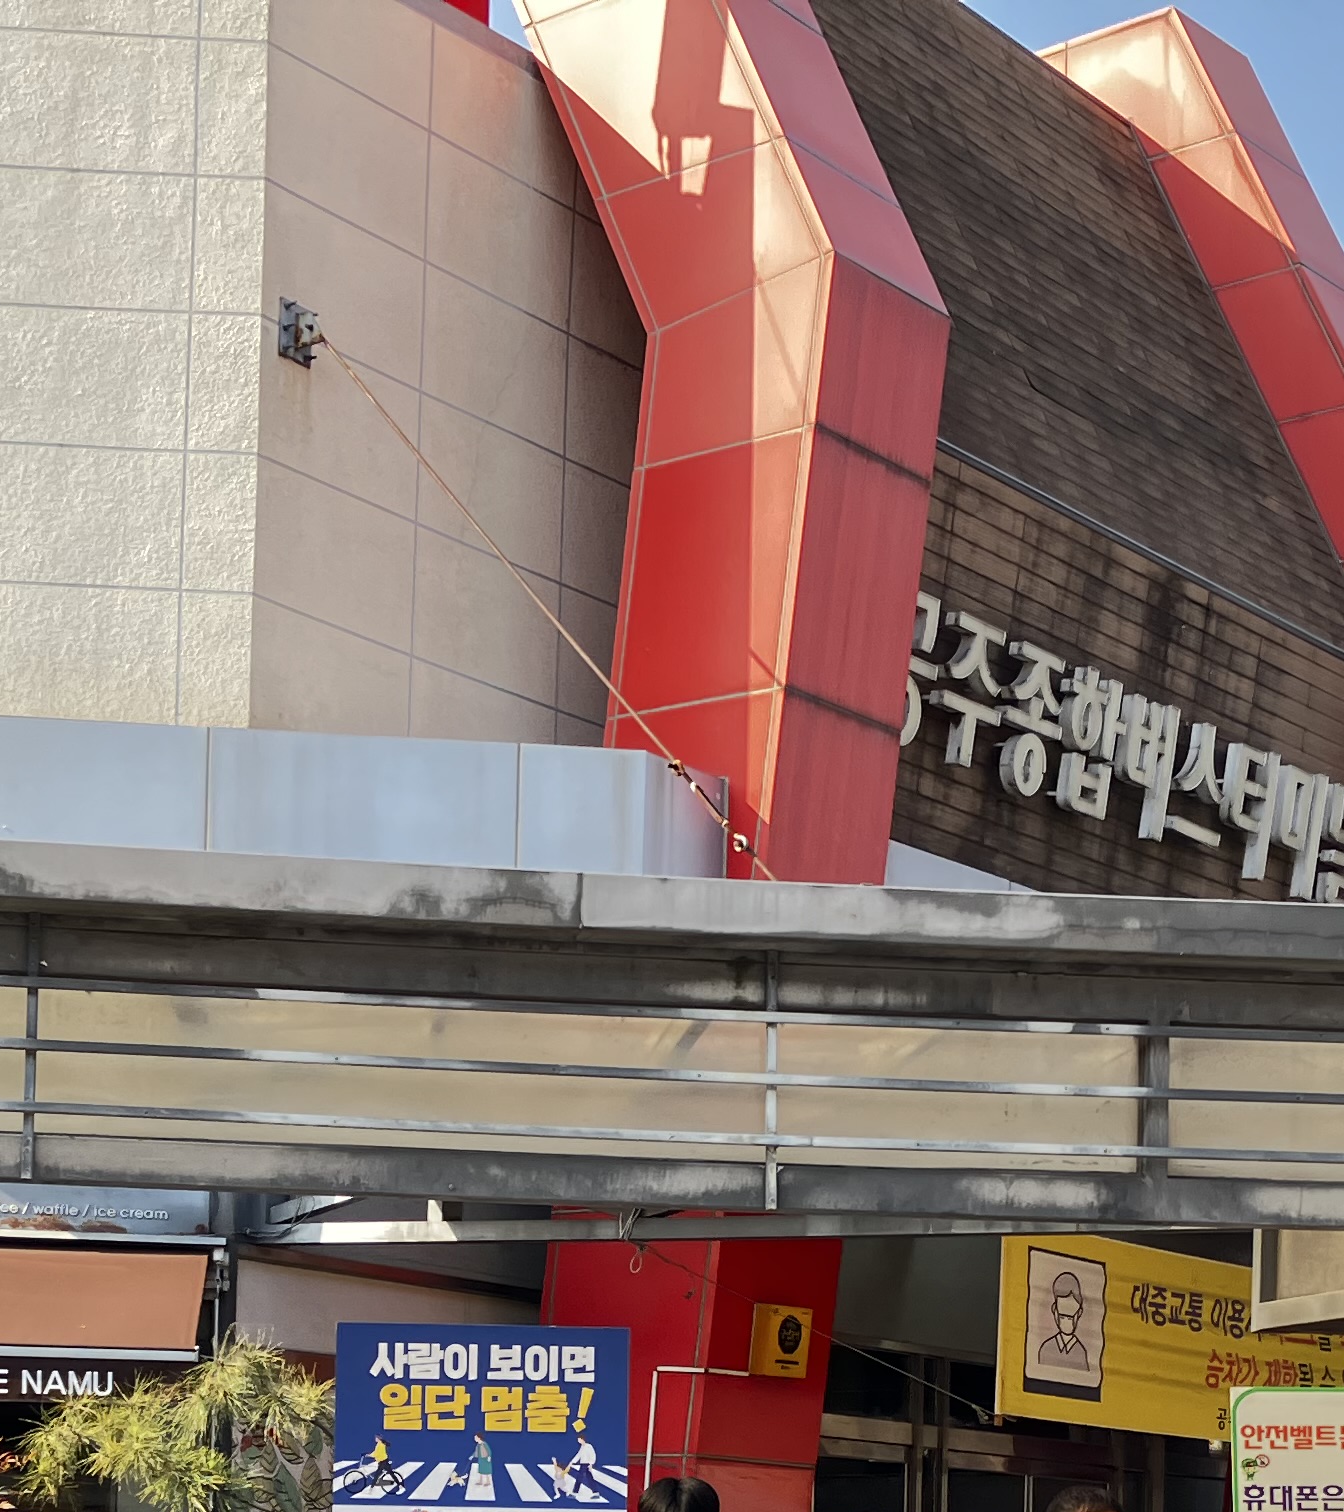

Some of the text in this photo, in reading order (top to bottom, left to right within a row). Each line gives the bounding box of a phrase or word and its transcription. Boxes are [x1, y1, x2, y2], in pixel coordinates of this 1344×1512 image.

[32, 1203, 79, 1217] waffle
[93, 1205, 116, 1218] ice
[120, 1208, 169, 1220] cream
[1130, 1282, 1262, 1341] 대중교통 이용
[369, 1341, 596, 1383] 사람이 보이면
[1204, 1349, 1260, 1389] 승차가
[21, 1369, 114, 1396] NAMU
[379, 1383, 595, 1433] 일단 멈춤!
[1242, 1484, 1344, 1512] 휴대폰은
